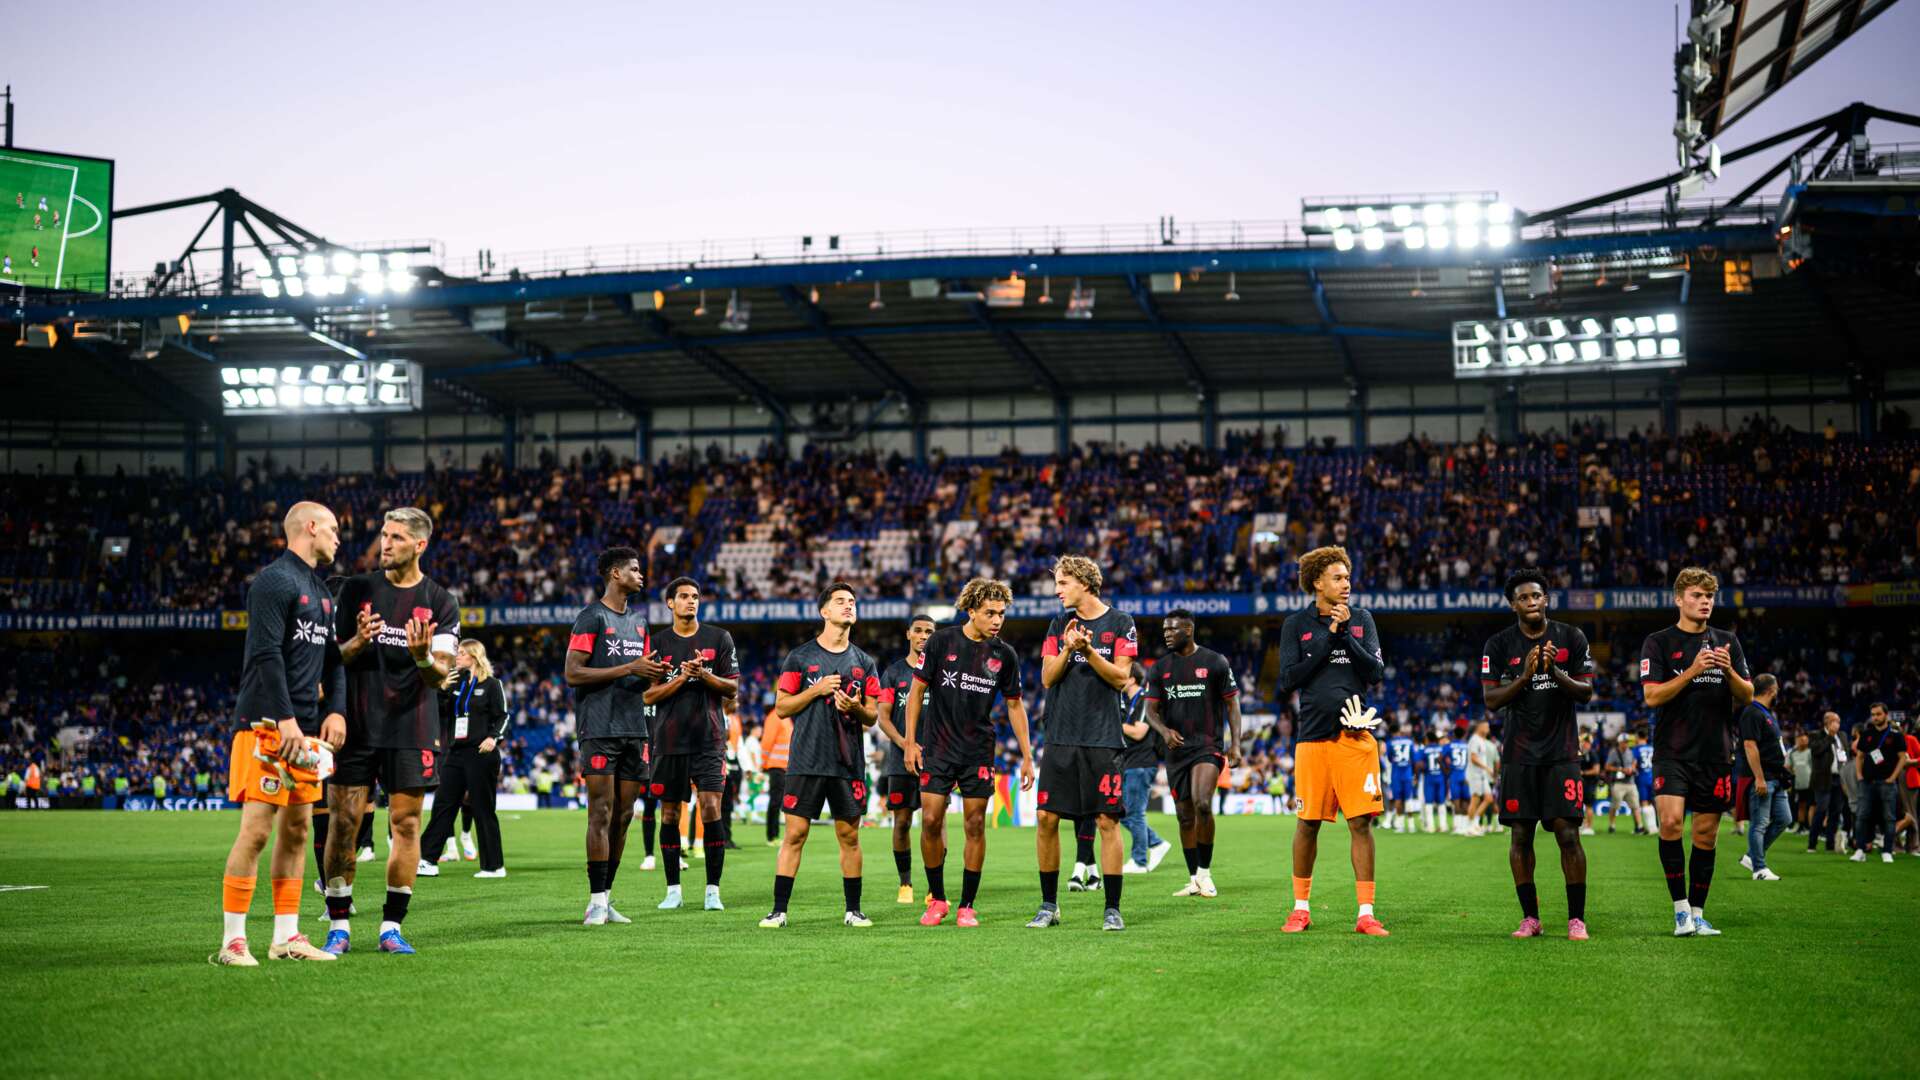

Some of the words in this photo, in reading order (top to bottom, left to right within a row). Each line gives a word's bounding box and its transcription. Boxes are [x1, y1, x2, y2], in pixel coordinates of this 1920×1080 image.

[1163, 599, 1230, 614] LONDON
[1276, 594, 1313, 610] SUP
[1354, 593, 1437, 609] FRANKIE
[1444, 591, 1511, 608] LAMPA
[1612, 591, 1661, 608] TAKING
[377, 634, 409, 648] Gotha
[961, 672, 997, 687] Barmenia
[960, 681, 992, 695] Gothaer
[1177, 683, 1206, 692] Barmenia
[1177, 690, 1202, 699] Gothaer
[1393, 744, 1411, 763] 34
[1098, 773, 1122, 796] 42
